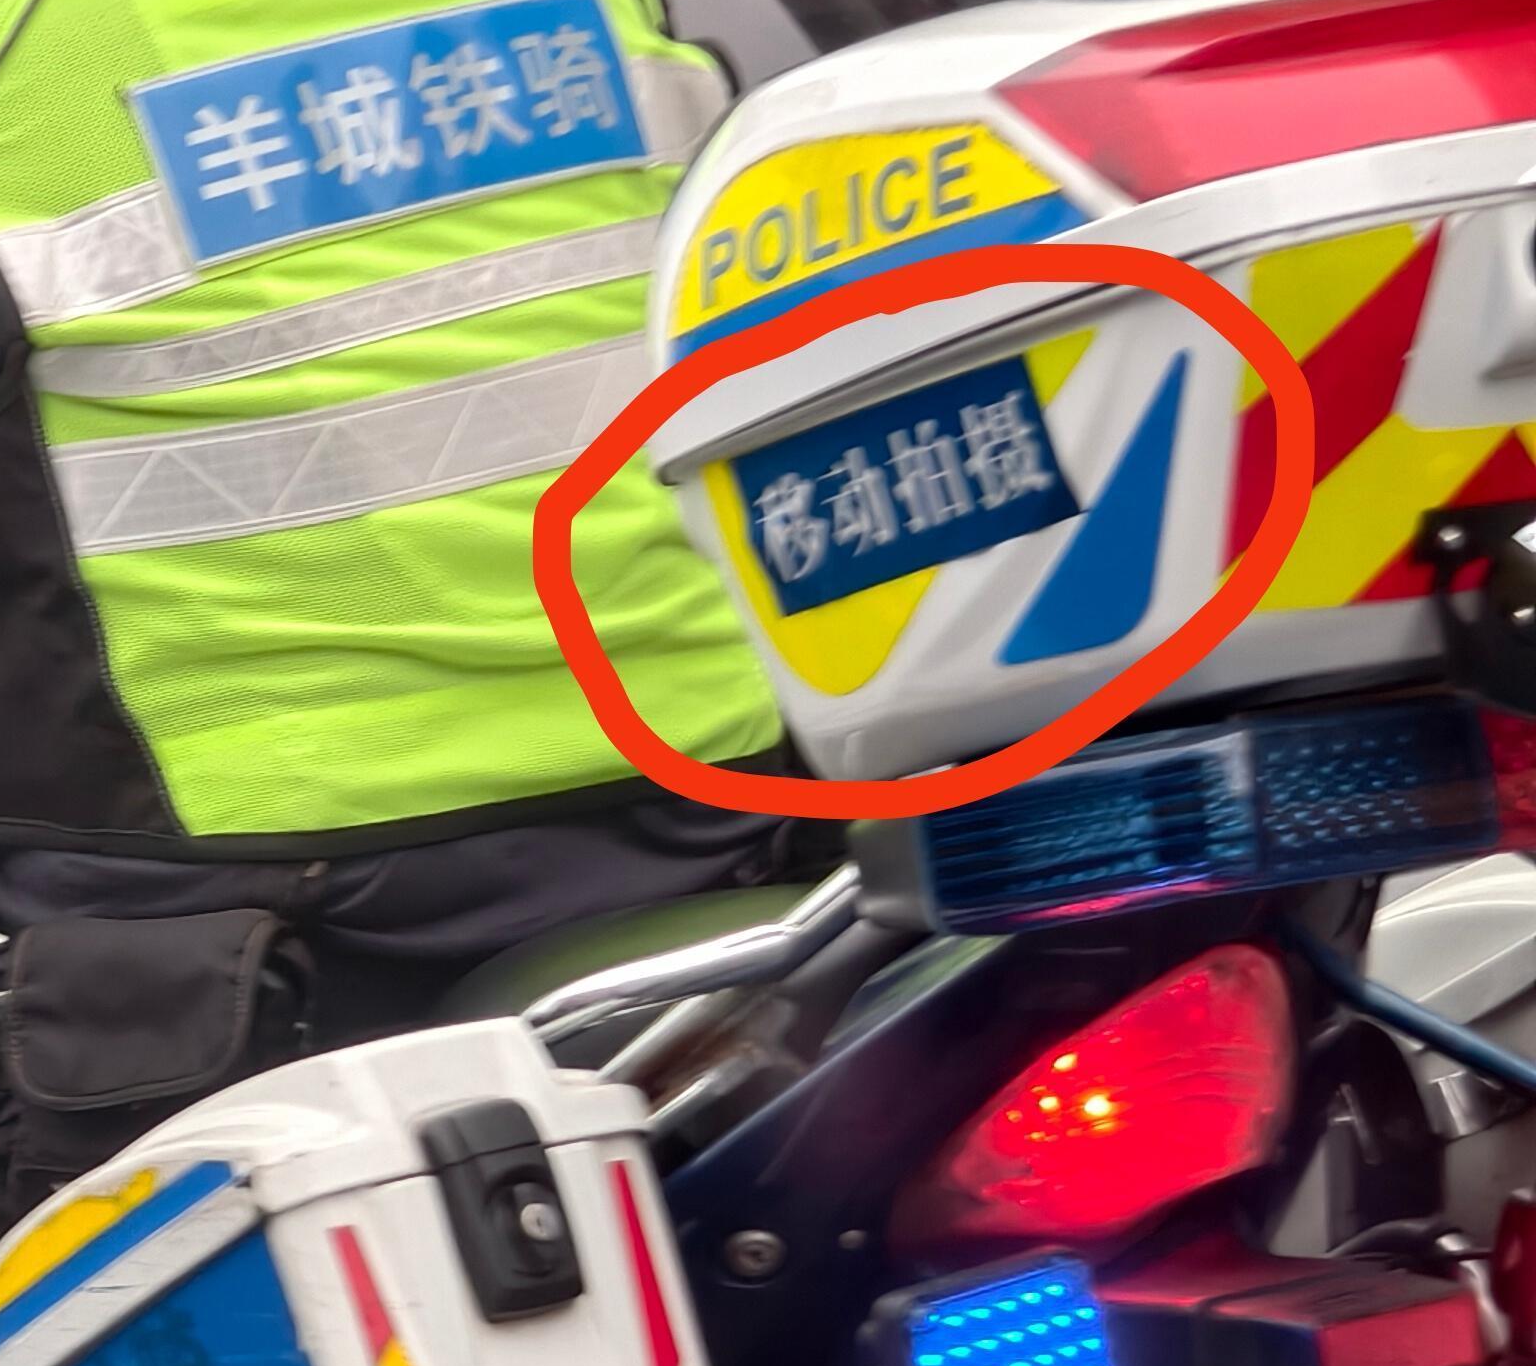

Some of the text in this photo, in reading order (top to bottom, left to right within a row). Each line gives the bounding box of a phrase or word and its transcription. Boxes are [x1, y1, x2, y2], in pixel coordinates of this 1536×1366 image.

[183, 23, 620, 213] 羊城铁骑
[700, 134, 978, 313] POLICE
[752, 388, 1055, 584] 移动拍摄
